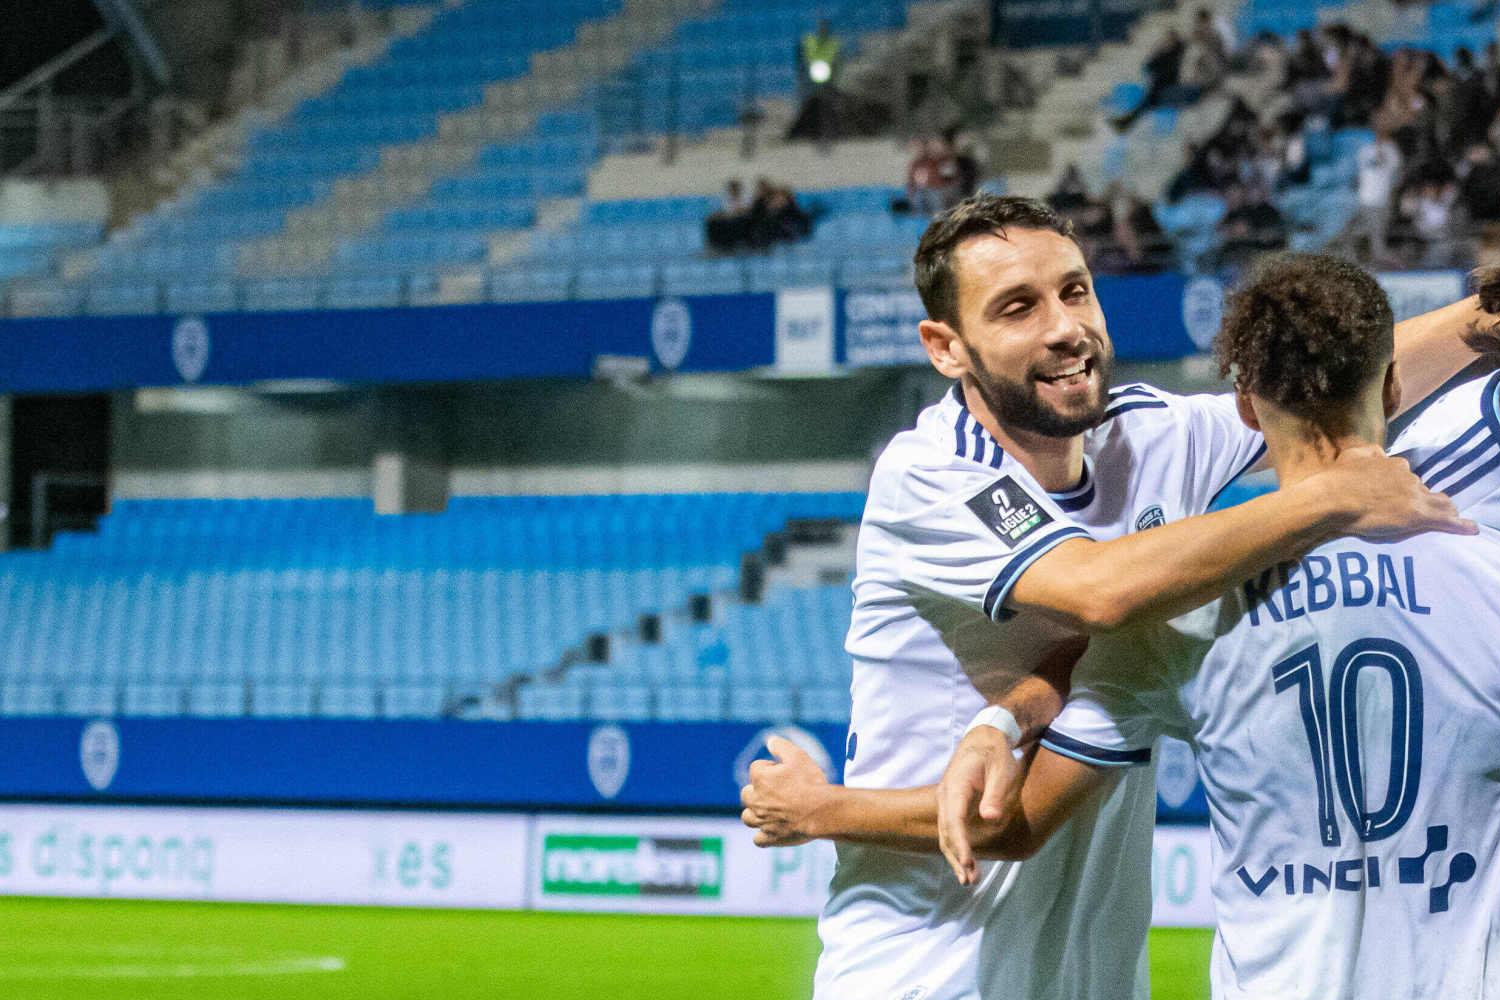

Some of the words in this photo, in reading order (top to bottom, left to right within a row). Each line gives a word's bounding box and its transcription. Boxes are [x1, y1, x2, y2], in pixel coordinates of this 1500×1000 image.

[995, 508, 1031, 536] LIGUE
[1024, 503, 1038, 516] 2
[1243, 551, 1432, 627] KEBBAL
[1271, 637, 1425, 847] 10
[1237, 856, 1381, 897] VINCI
